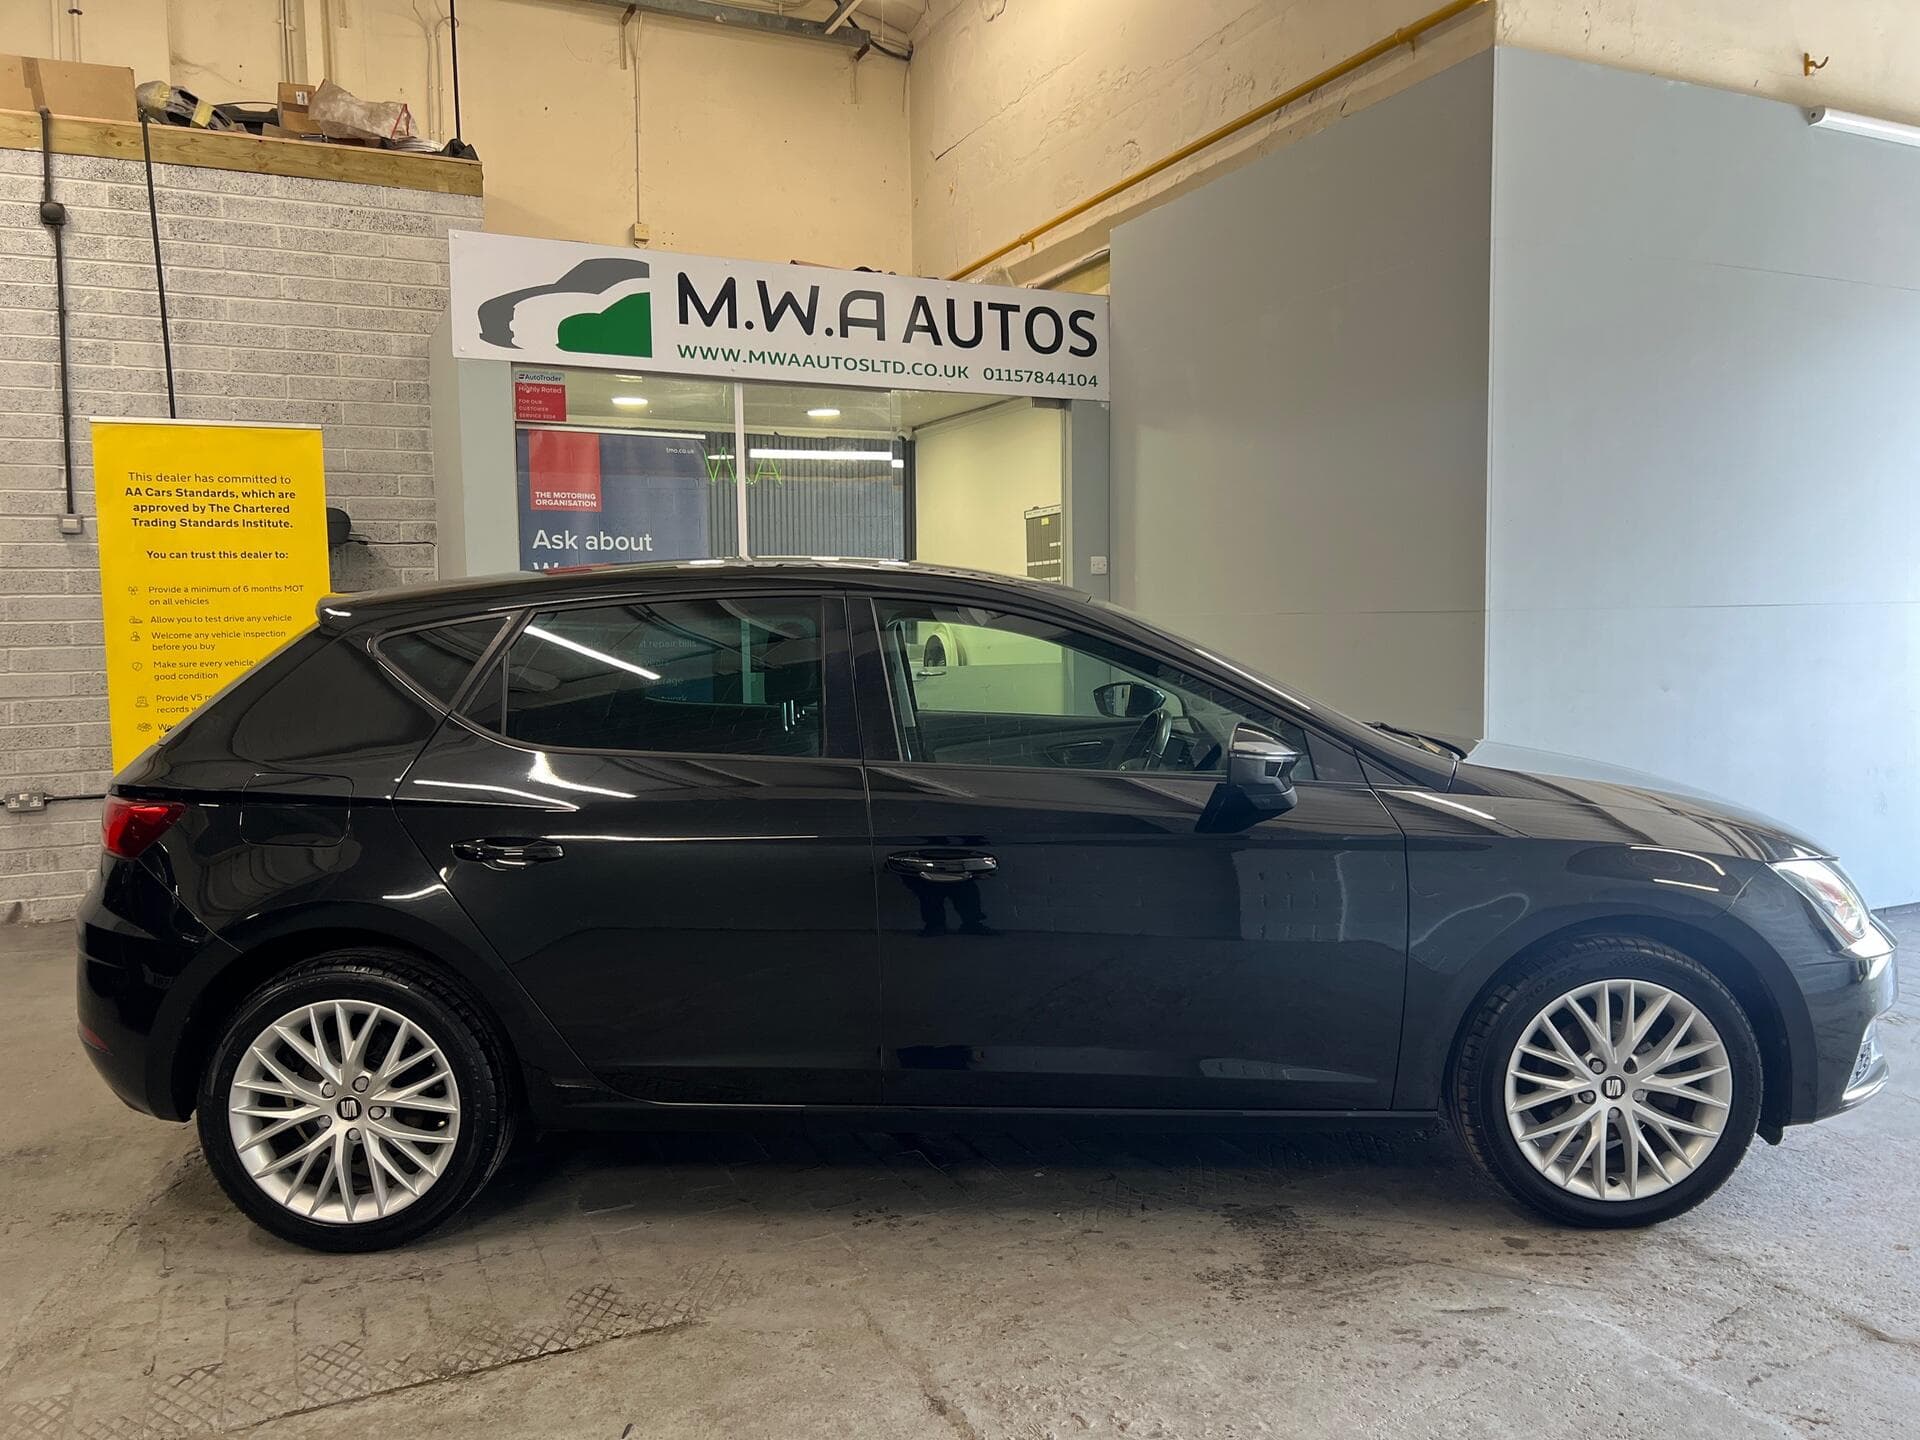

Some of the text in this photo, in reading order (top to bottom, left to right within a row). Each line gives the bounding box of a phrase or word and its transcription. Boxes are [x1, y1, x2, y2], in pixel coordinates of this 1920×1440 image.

[678, 271, 1098, 358] M.W.A AUTOS
[676, 344, 1099, 388] WWW.MWAAUTOSLTD.CO.UK 01157844104
[518, 385, 540, 393] Highly
[128, 472, 291, 485] This dealer has committed to
[125, 487, 296, 500] AA Cars Standards, which are
[553, 492, 596, 500] MOTORING
[535, 499, 597, 508] ORGANISATION
[133, 503, 290, 514] approved by The Chartered
[132, 518, 293, 529] Trading Standards Institute.
[532, 529, 653, 552] Ask about
[146, 550, 167, 559] You
[191, 550, 216, 559] trust
[218, 550, 238, 559] this
[240, 550, 272, 559] dealer
[274, 551, 289, 559] to:
[148, 586, 181, 594] Provide
[162, 598, 173, 606] all
[175, 598, 210, 606] vehicles
[150, 616, 175, 624] Allow
[176, 617, 192, 625] you
[246, 616, 260, 624] any
[263, 614, 292, 622] vehicle
[152, 632, 192, 640] Welcome
[194, 632, 208, 640] any
[243, 631, 286, 639] inspection
[182, 644, 198, 652] you
[200, 643, 216, 651] buy
[154, 672, 218, 681] good condition
[156, 694, 188, 702] Provide
[157, 706, 190, 714] records
